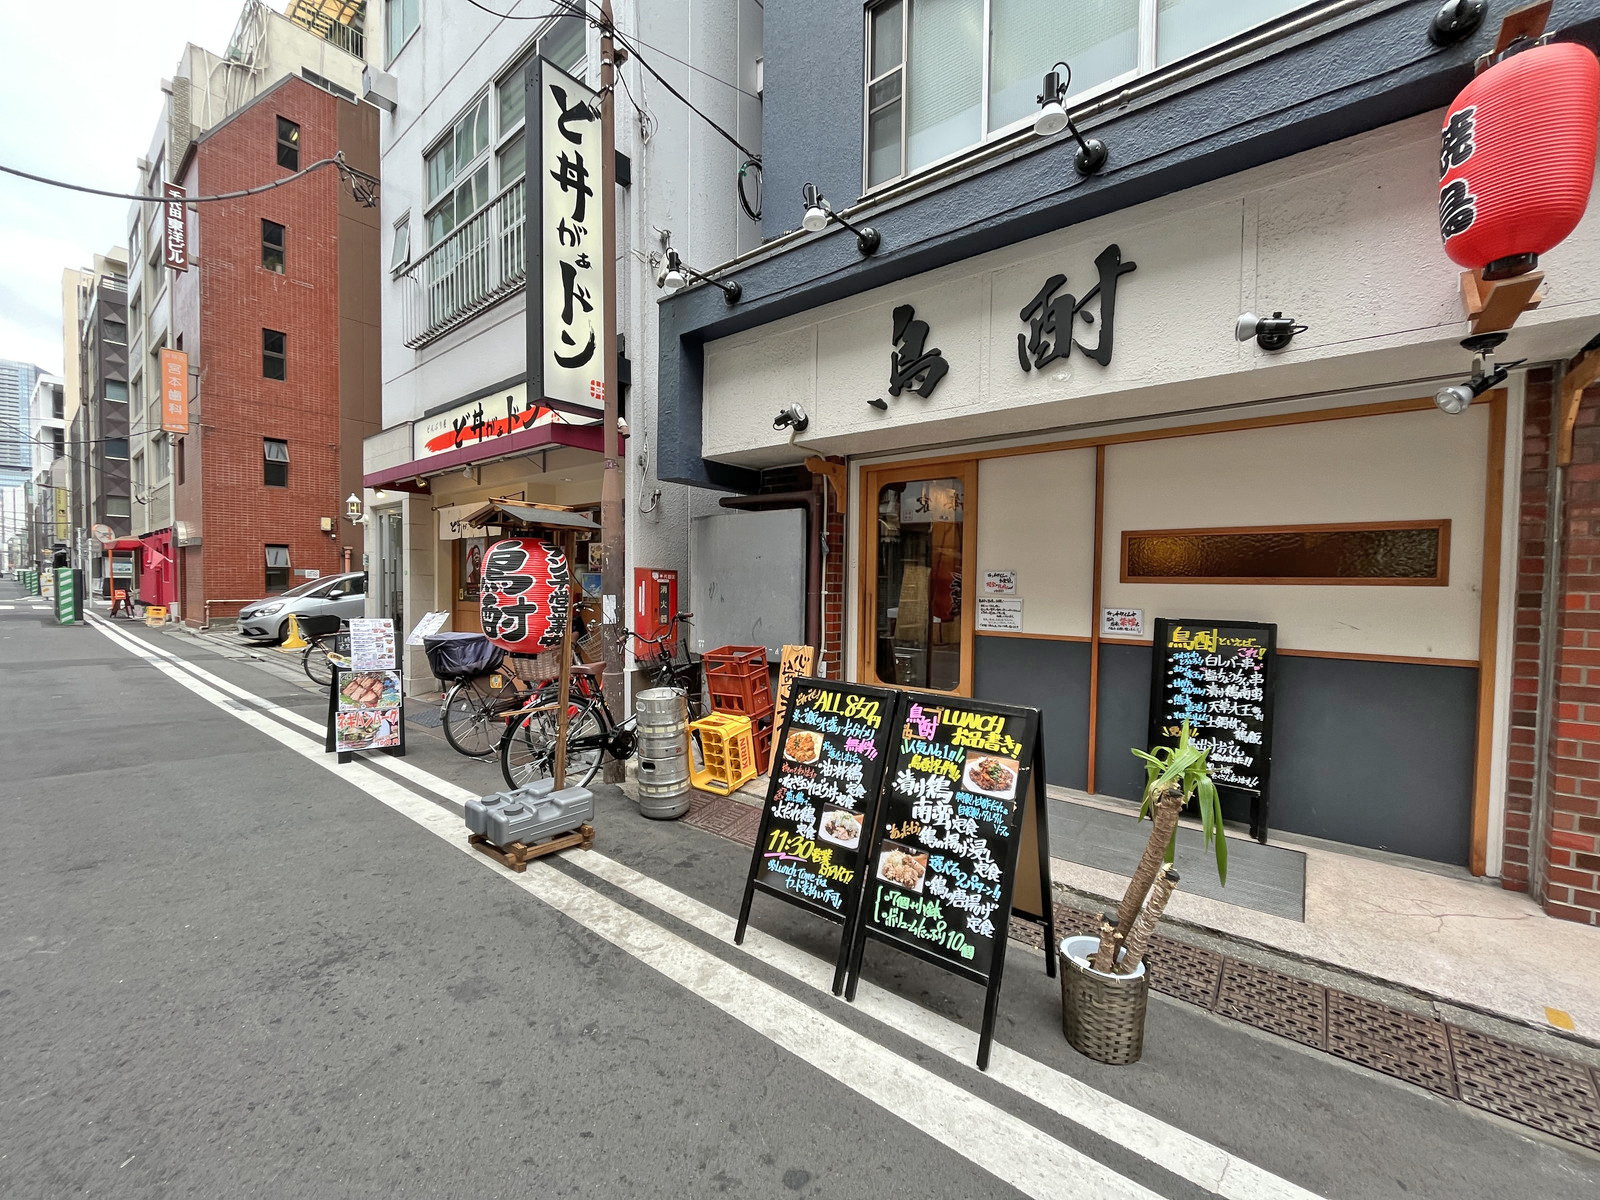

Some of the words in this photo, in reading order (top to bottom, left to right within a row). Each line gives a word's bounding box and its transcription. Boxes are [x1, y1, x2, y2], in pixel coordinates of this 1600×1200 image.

[867, 244, 1137, 411] 鳥酎
[481, 540, 538, 642] 鳥酎
[1205, 654, 1255, 670] 白レバー串
[338, 709, 397, 728] ネギハンバーグ
[942, 709, 1005, 733] LUNCH
[740, 737, 749, 769] KIRIN
[973, 861, 1002, 882] 定食
[966, 914, 995, 938] 定食
